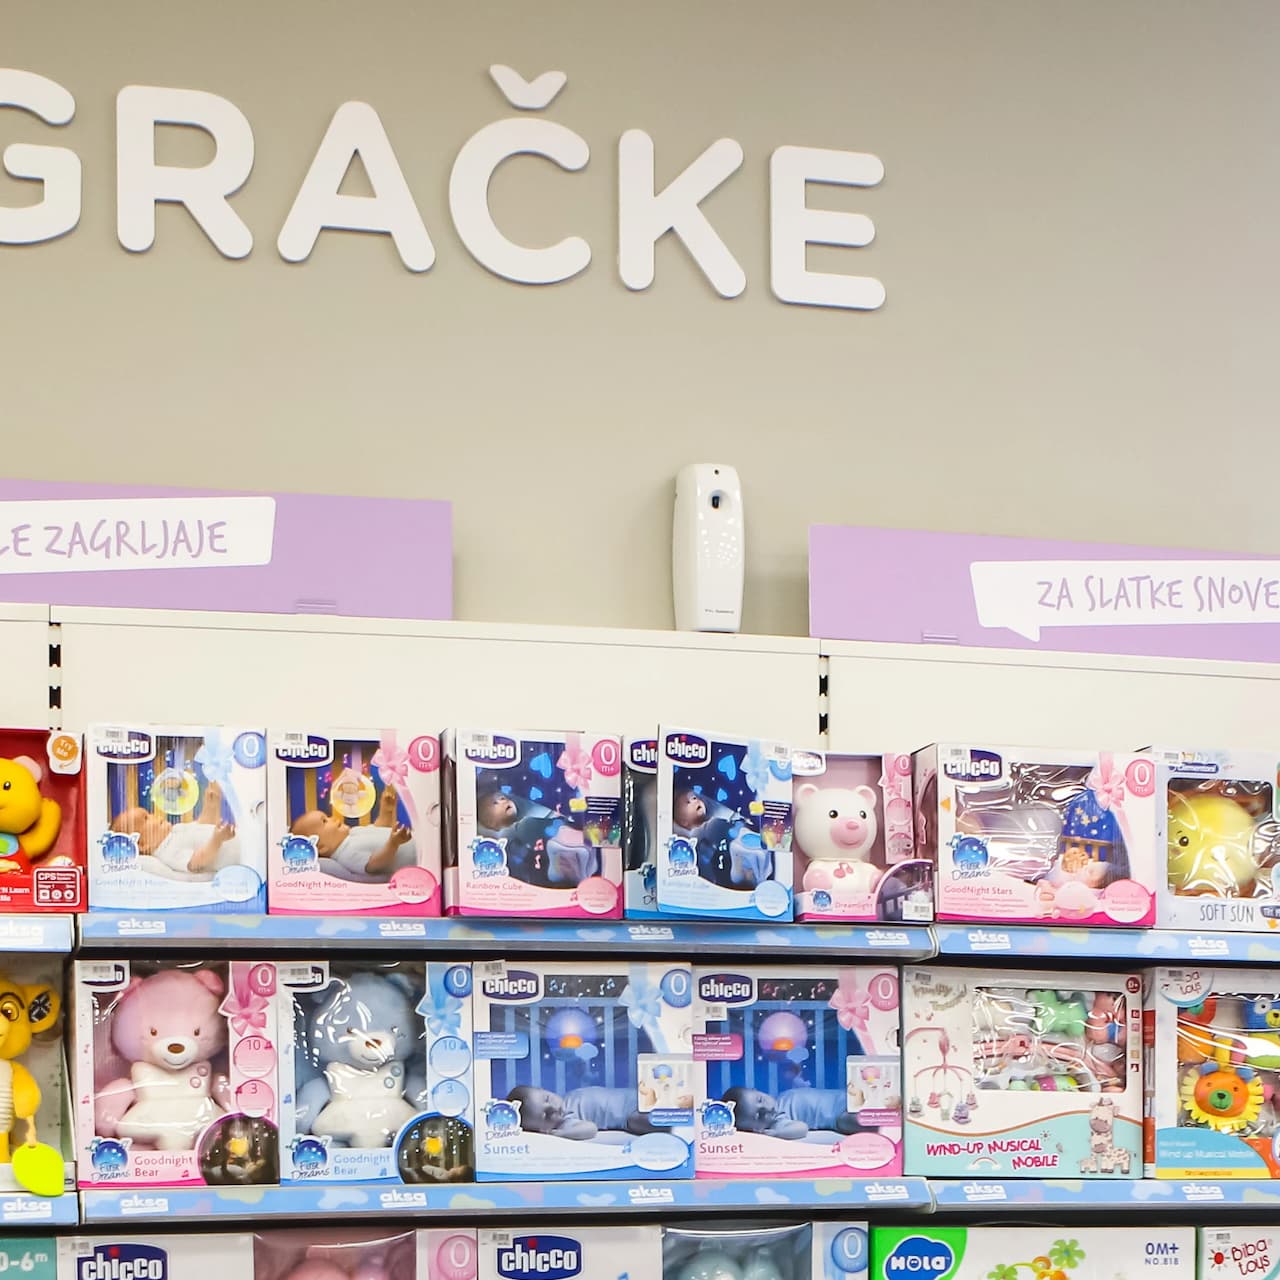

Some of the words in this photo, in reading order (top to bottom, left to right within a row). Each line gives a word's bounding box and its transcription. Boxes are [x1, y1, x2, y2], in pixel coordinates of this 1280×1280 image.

[43, 519, 229, 561] ZAGRLJAJE
[1036, 576, 1074, 612] ZA
[1085, 576, 1183, 612] SLATKE
[1193, 574, 1280, 611] SNOVE
[667, 736, 706, 759] chicco
[466, 882, 502, 891] Rainbow
[504, 882, 523, 891] Cube
[944, 886, 985, 897] GoodNight
[988, 886, 1013, 895] Stars
[1199, 904, 1225, 921] SOFT
[1230, 905, 1253, 923] SUN
[379, 921, 425, 933] aksa
[486, 972, 537, 997] chicco
[701, 973, 750, 999] chicco
[483, 1142, 530, 1155] Sunset
[699, 1141, 744, 1154] Sunset
[926, 1140, 984, 1157] WIND-UP
[989, 1138, 1042, 1155] MUSICAL
[134, 1155, 194, 1169] Goodnight
[333, 1153, 390, 1167] Goodnight
[1012, 1152, 1059, 1169] MOBILE
[134, 1167, 159, 1178] Bear
[334, 1165, 358, 1175] Bear
[628, 1186, 673, 1199] aksa
[501, 1239, 577, 1273] chicco
[1146, 1242, 1179, 1255] 0M+
[1232, 1239, 1268, 1262] Biba
[1238, 1255, 1270, 1276] toys
